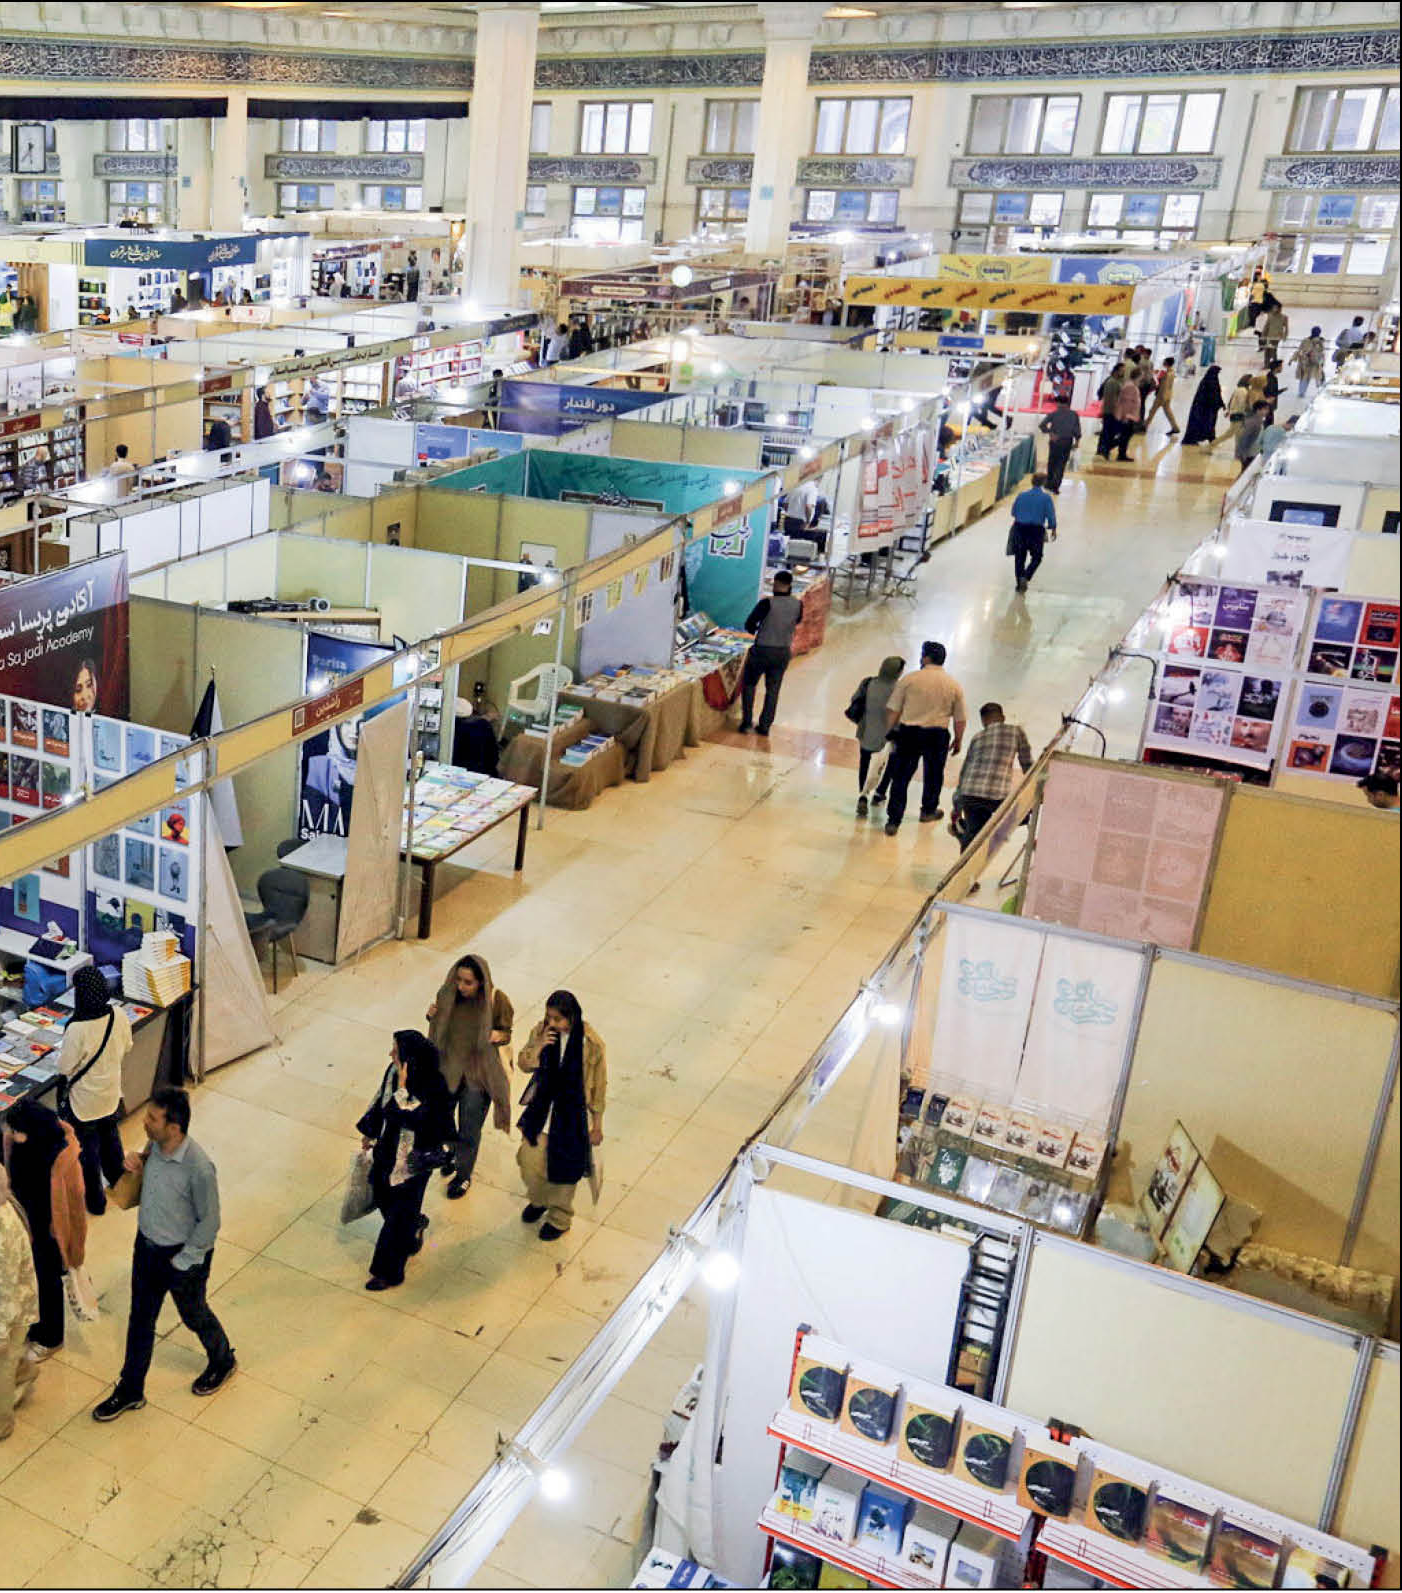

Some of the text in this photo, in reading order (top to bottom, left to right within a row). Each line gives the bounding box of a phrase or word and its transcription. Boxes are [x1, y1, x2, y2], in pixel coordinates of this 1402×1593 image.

[564, 396, 615, 413] دور اقتدار
[55, 579, 95, 627] آکادمی
[18, 608, 54, 641] پریسا
[7, 642, 44, 667] Sajadi
[45, 625, 95, 653] Academy
